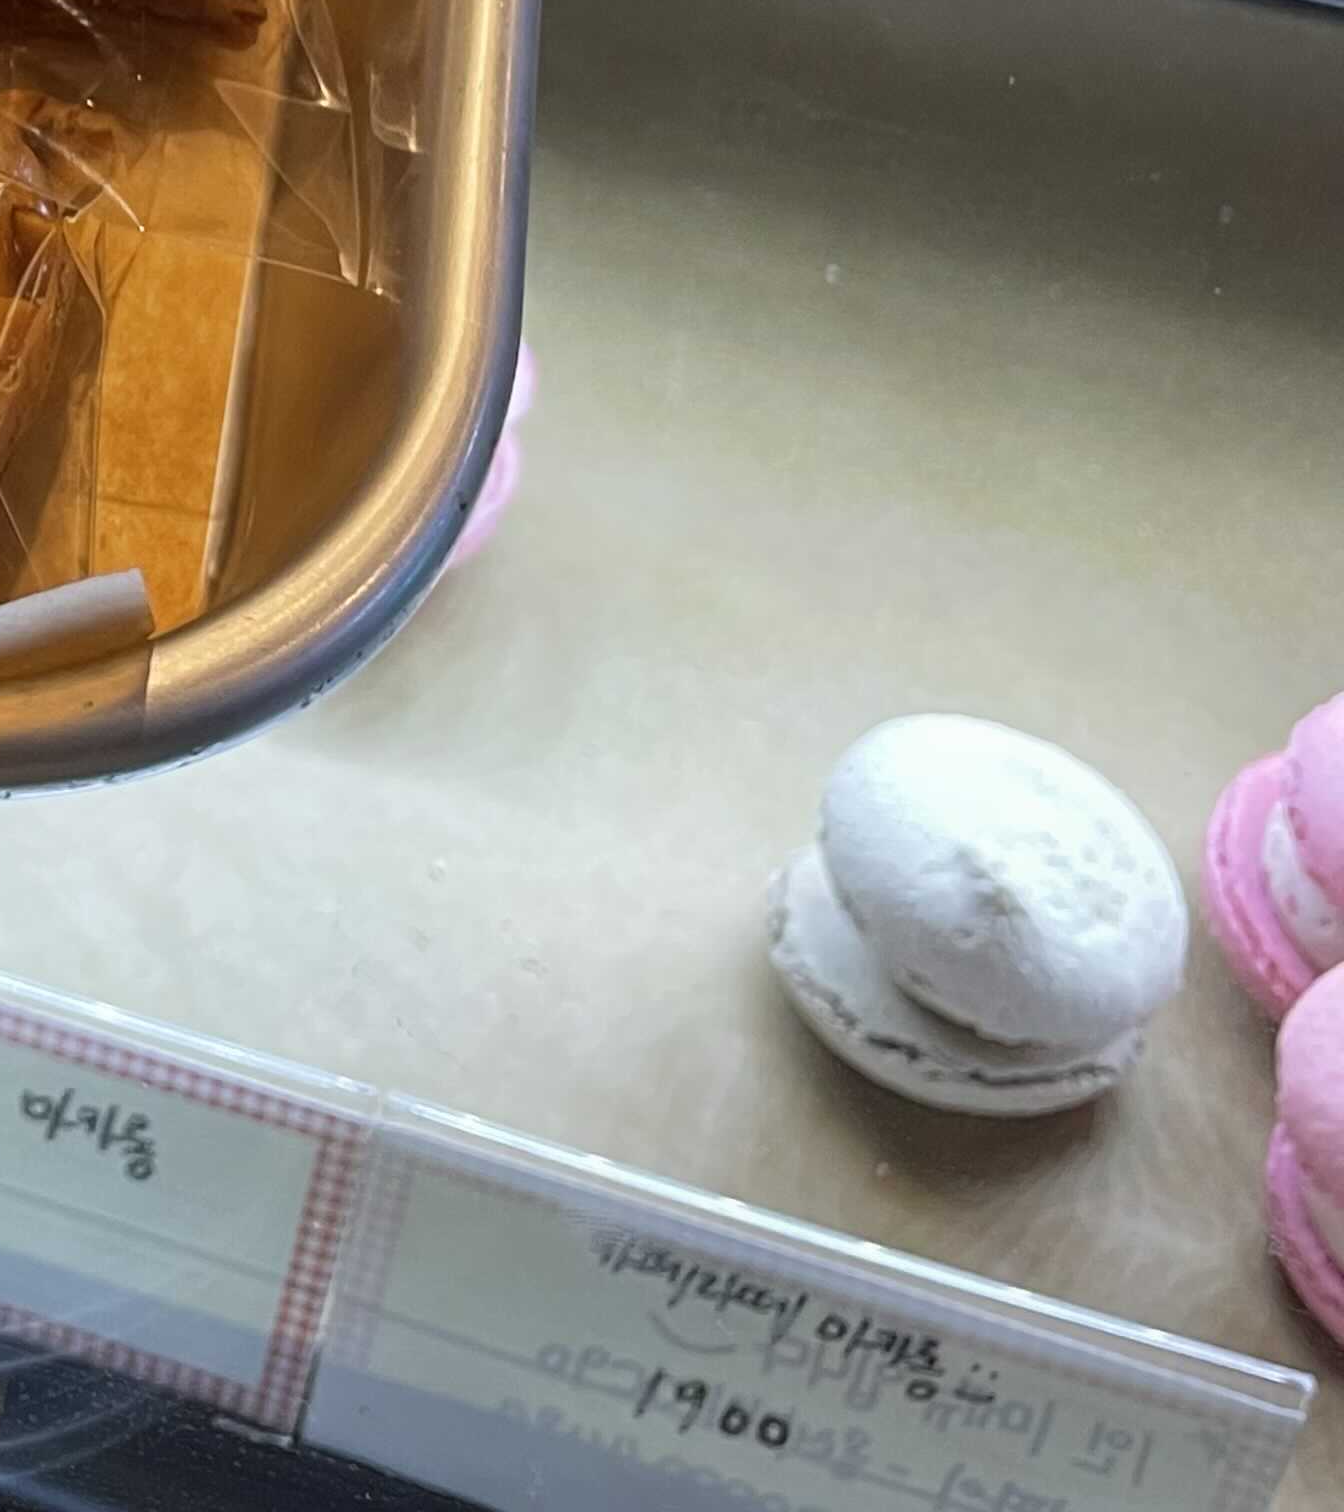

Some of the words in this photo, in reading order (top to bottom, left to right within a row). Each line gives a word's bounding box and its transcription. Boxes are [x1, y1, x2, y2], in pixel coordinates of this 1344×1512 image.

[19, 1088, 156, 1182] 마카롱
[816, 1314, 946, 1403] 마카롱
[633, 1367, 791, 1449] 1900
